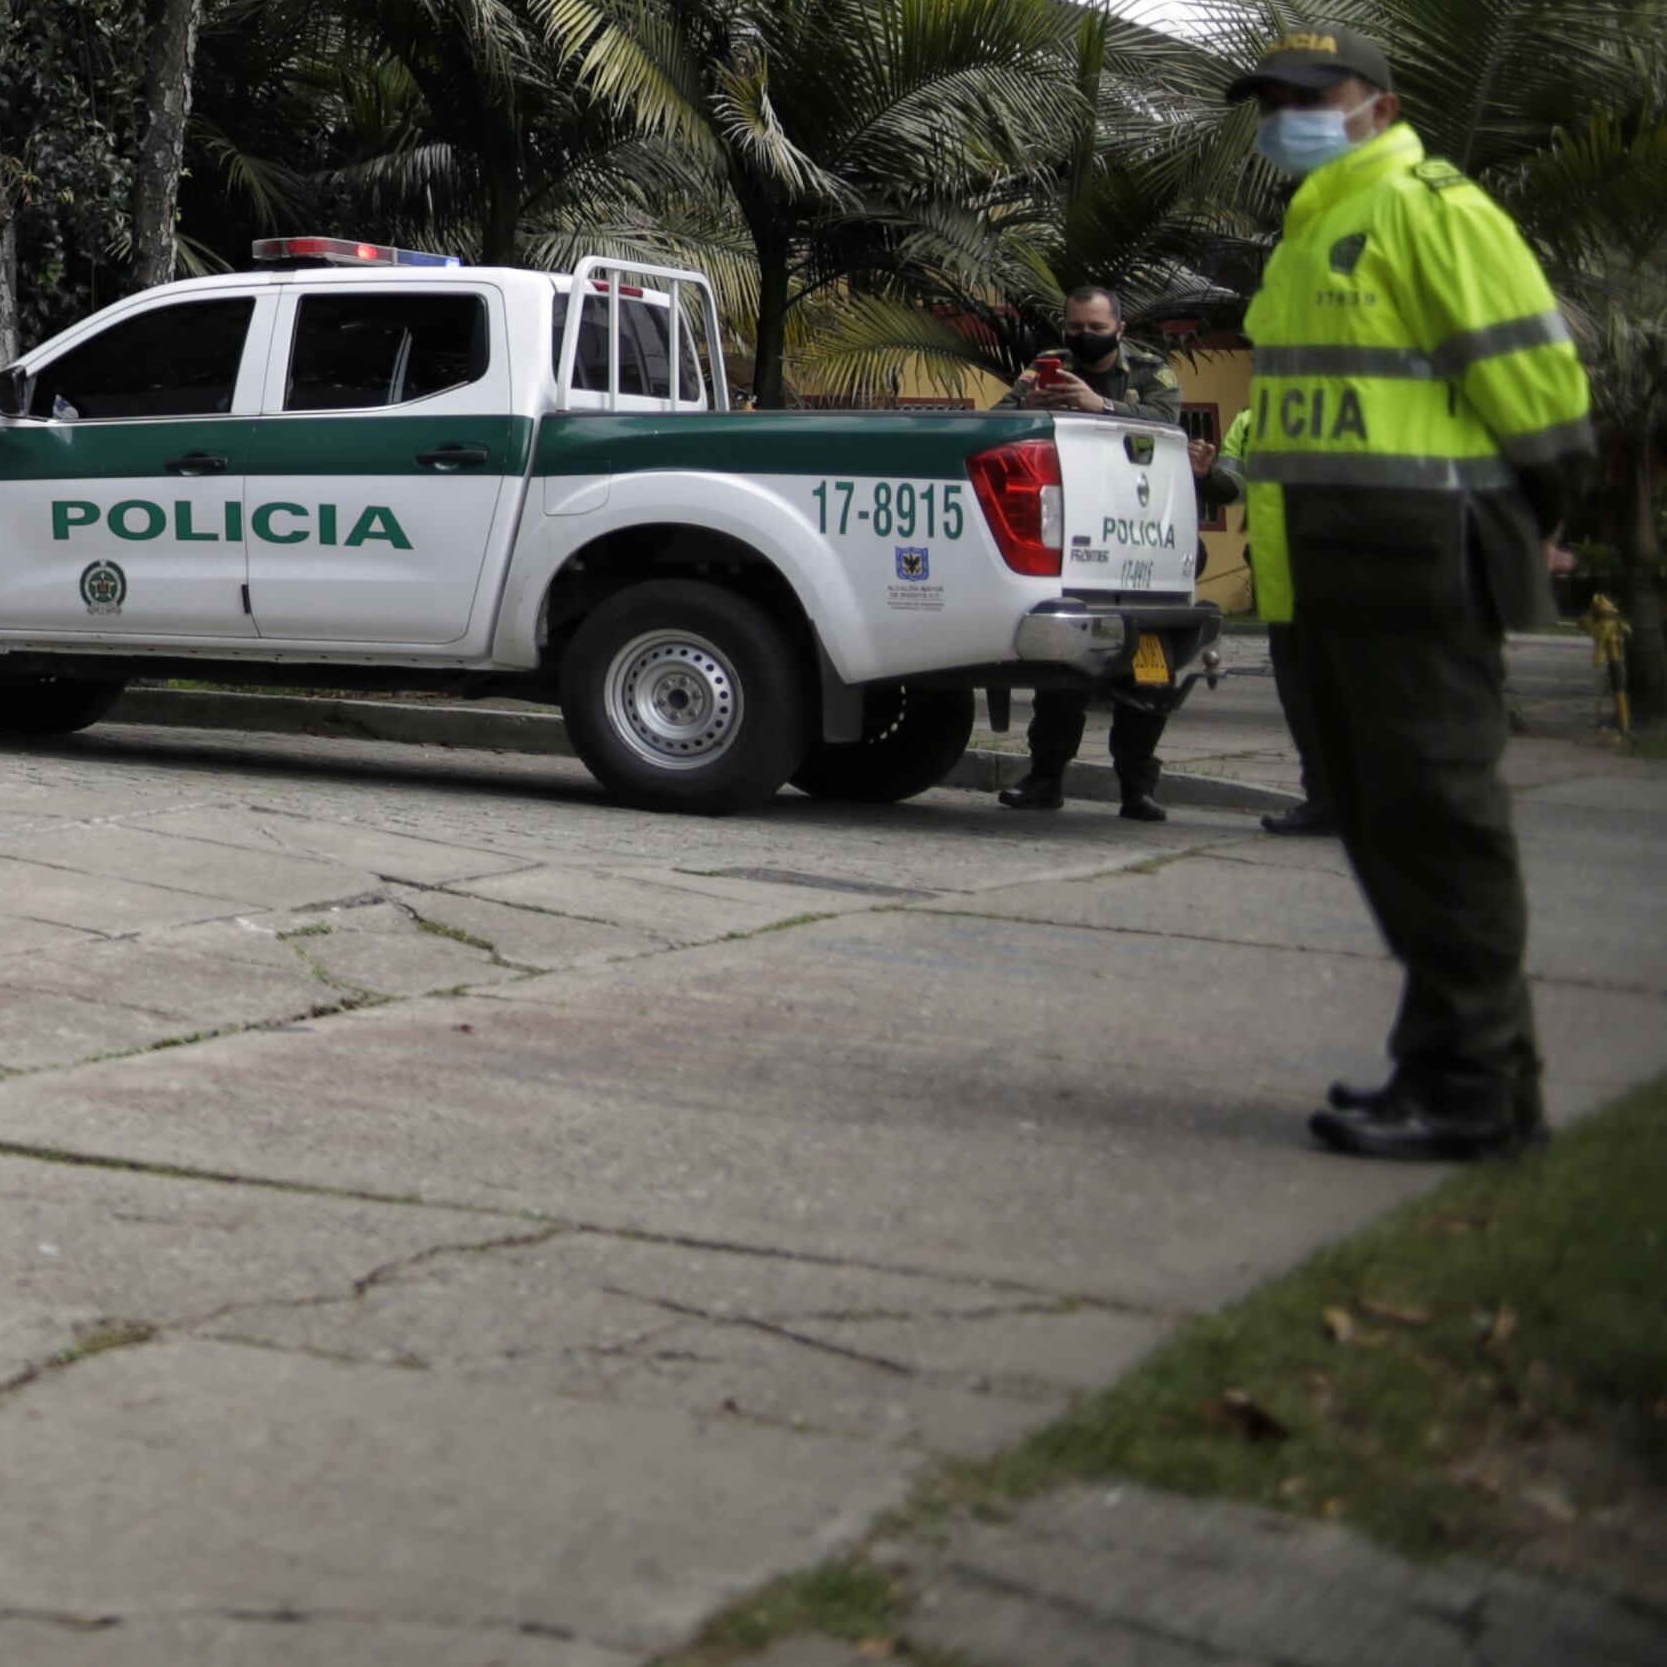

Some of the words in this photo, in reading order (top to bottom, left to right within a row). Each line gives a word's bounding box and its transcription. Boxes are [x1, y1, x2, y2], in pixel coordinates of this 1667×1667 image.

[51, 499, 413, 550] POLICIA
[812, 479, 964, 540] 17-8915
[1103, 517, 1175, 549] POLICIA
